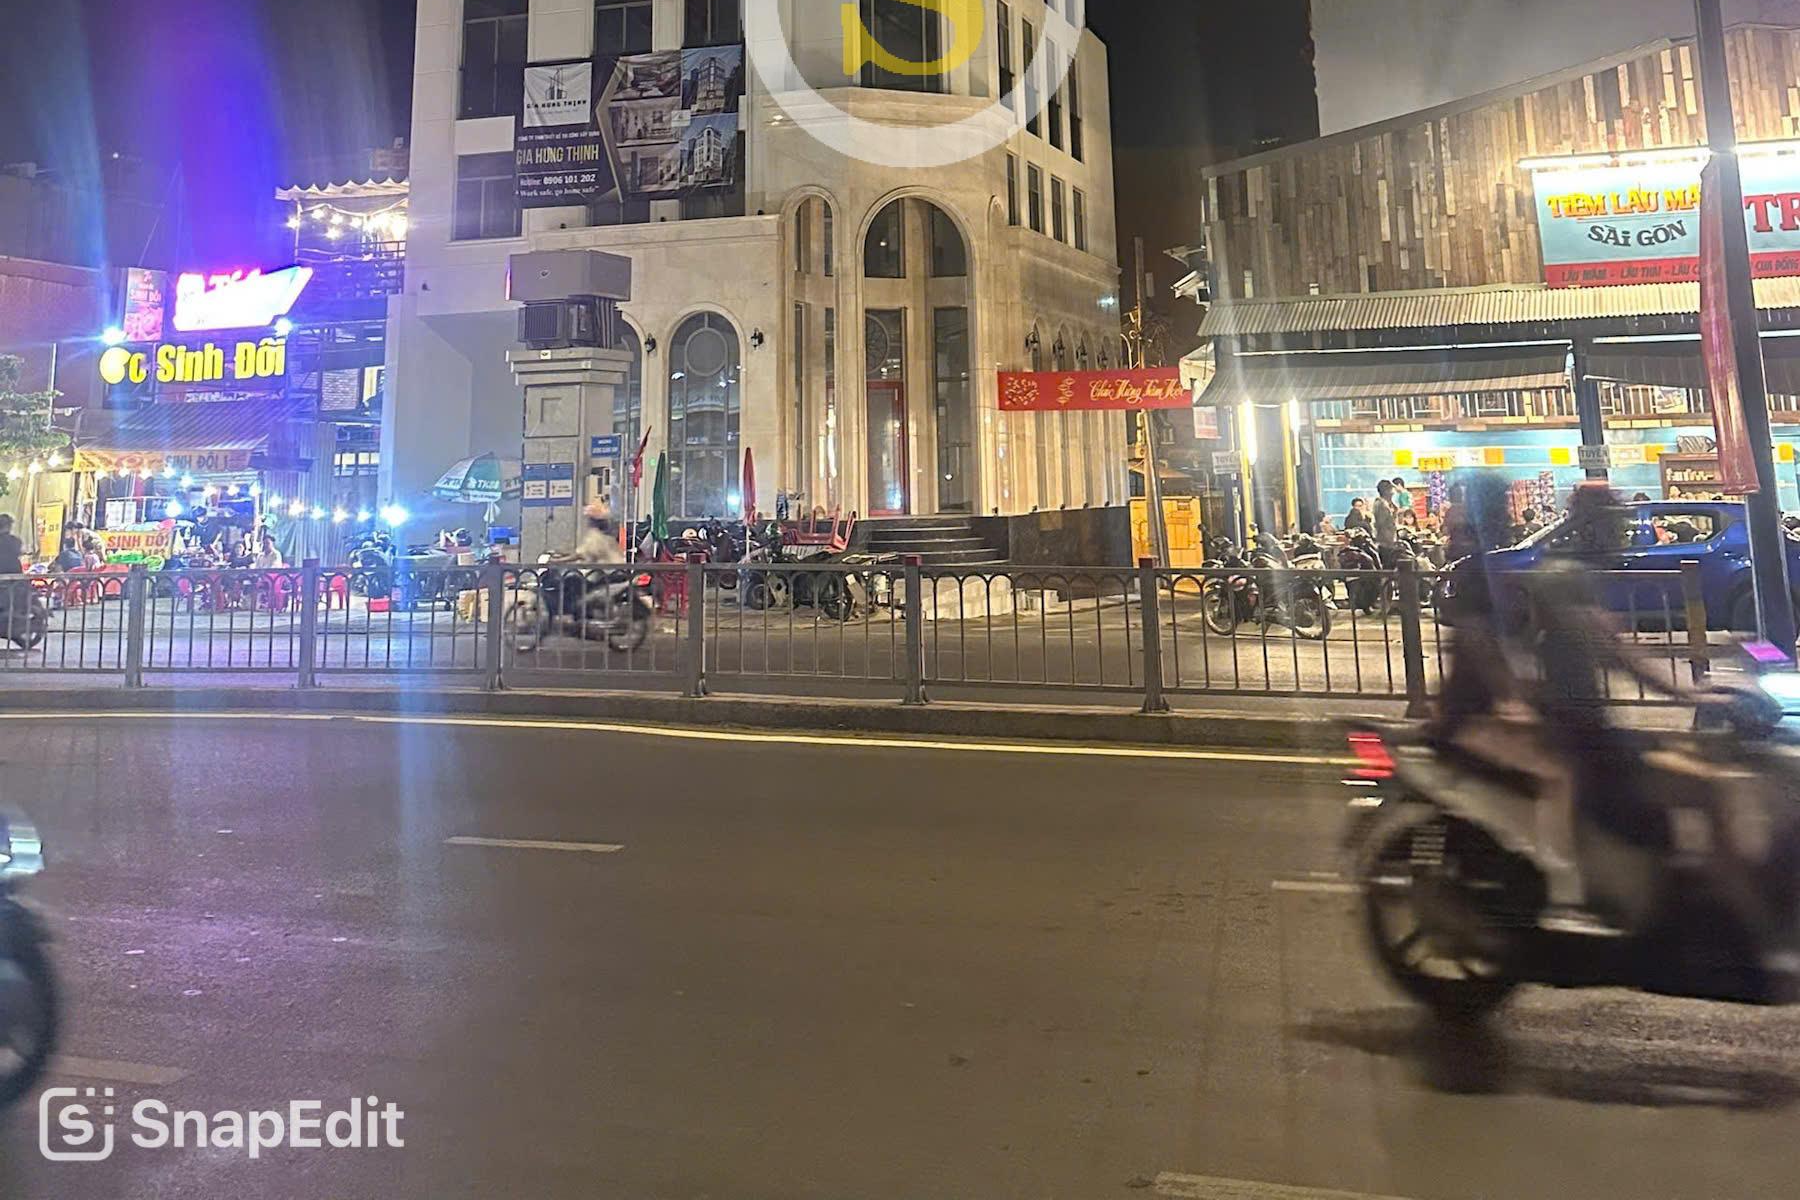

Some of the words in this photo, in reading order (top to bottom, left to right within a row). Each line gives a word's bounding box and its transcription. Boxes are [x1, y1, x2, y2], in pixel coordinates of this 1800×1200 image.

[516, 149, 533, 165] GIA
[566, 144, 599, 164] THỊNH
[564, 175, 578, 184] 101
[580, 174, 596, 182] 202
[156, 342, 224, 382] Sinh
[107, 535, 140, 547] SINH
